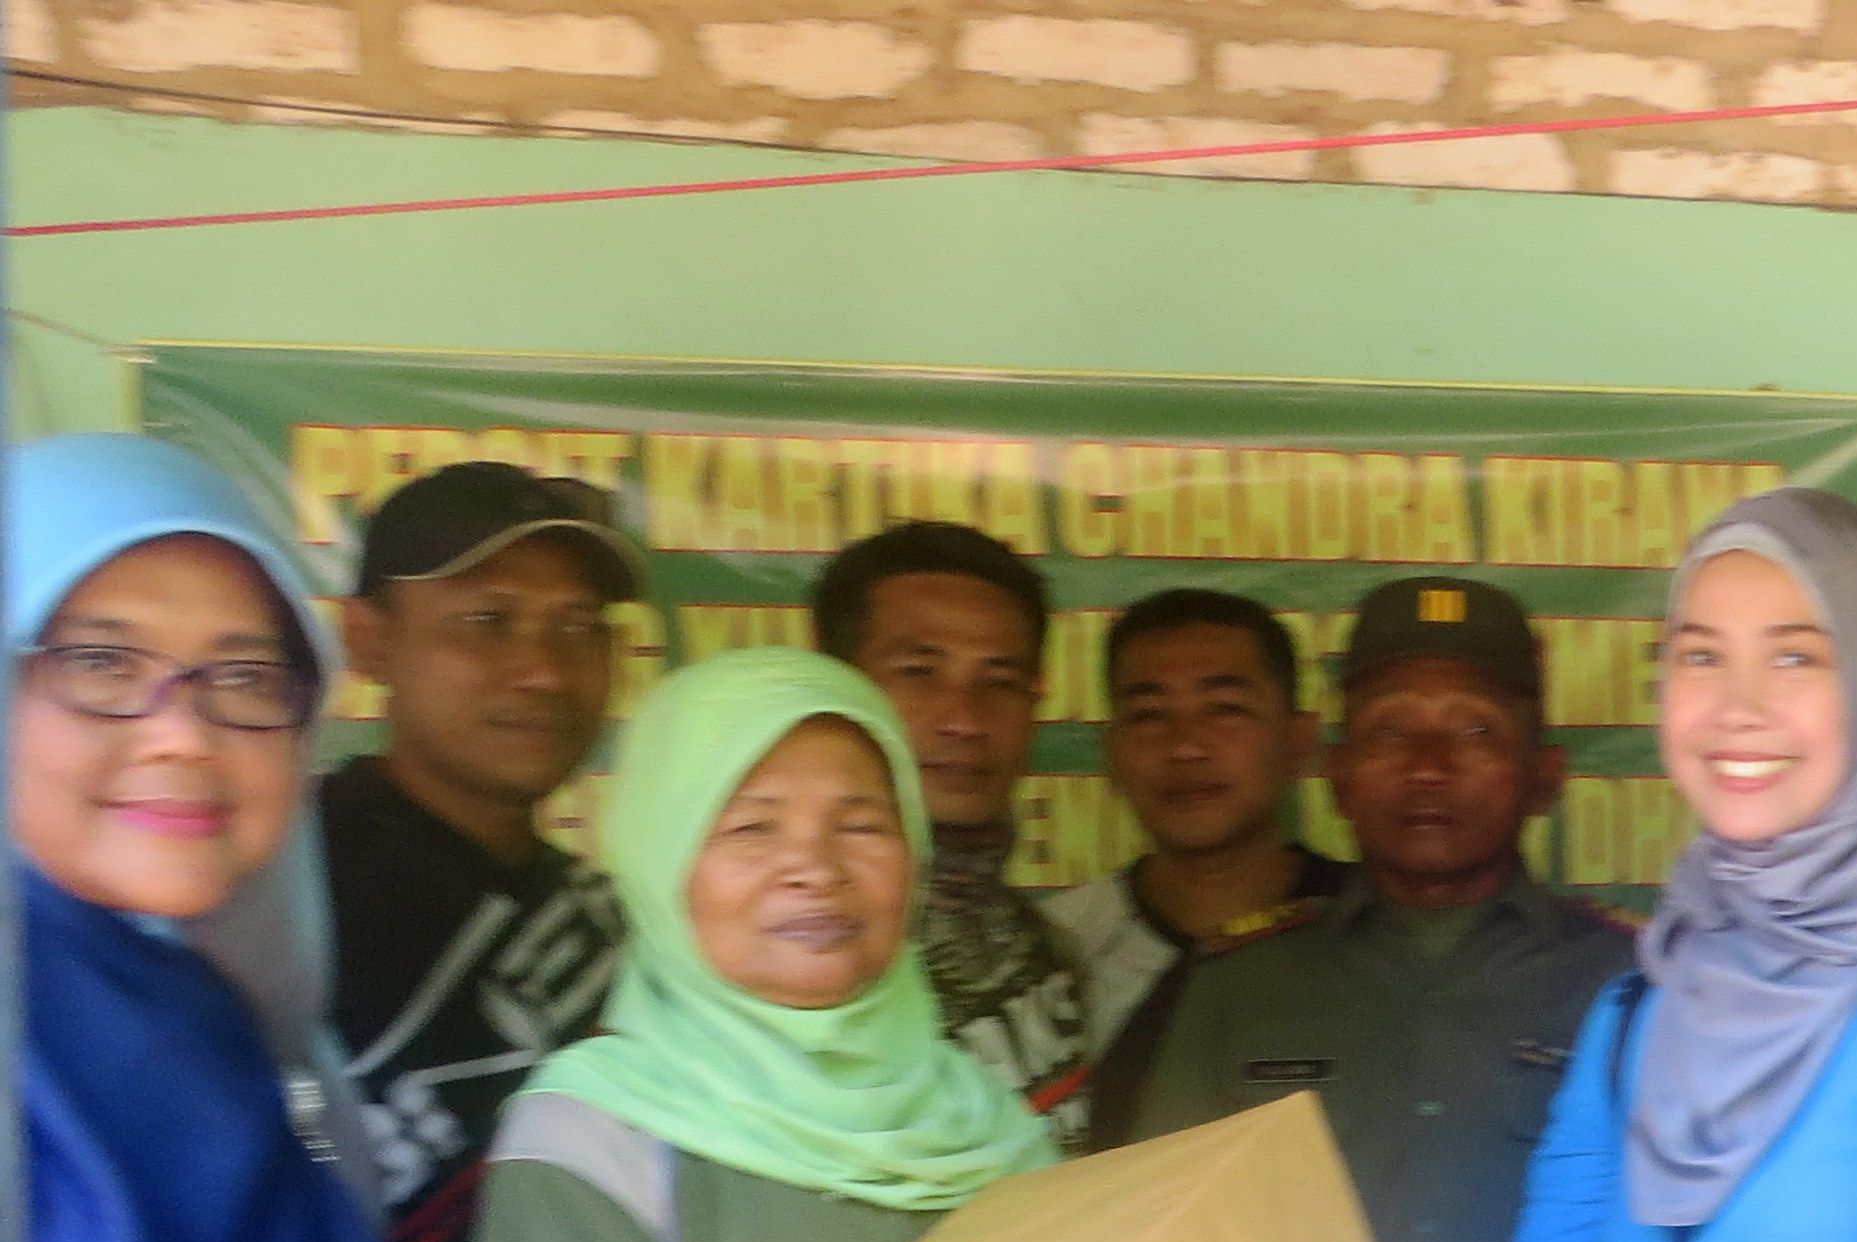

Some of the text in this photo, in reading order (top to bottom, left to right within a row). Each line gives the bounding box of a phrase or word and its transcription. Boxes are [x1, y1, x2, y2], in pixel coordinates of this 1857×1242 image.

[645, 432, 1050, 557] KARTIKA
[1062, 441, 1476, 564] CHANDRA
[1484, 455, 1783, 569] KIRAN
